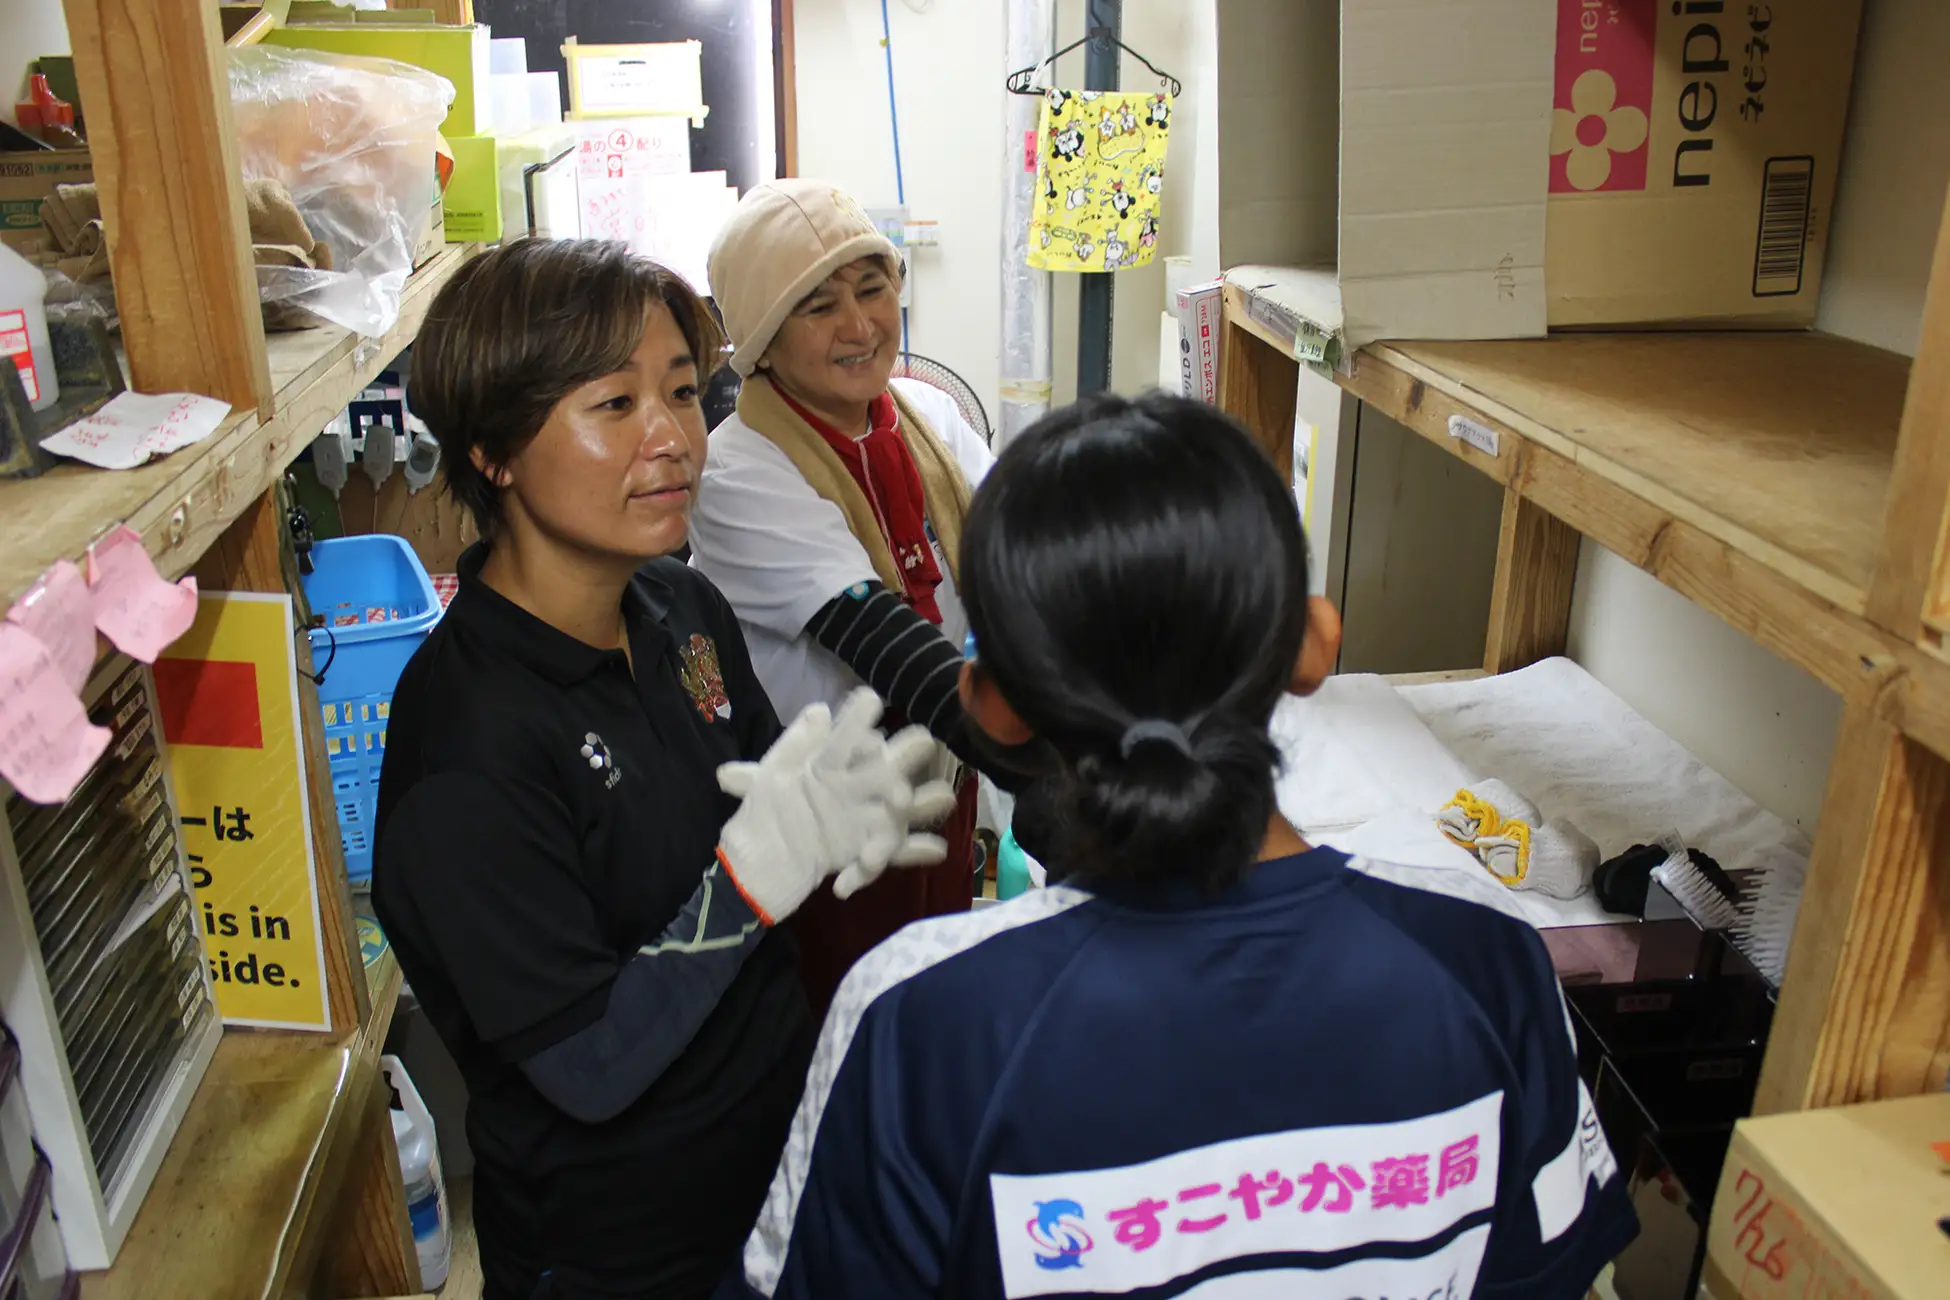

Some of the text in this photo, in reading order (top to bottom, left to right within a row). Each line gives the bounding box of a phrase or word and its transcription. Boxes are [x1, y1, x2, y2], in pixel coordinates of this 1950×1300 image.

[1672, 0, 1730, 188] nepi
[203, 902, 291, 941] is in
[1106, 1133, 1480, 1252] すこやか薬局
